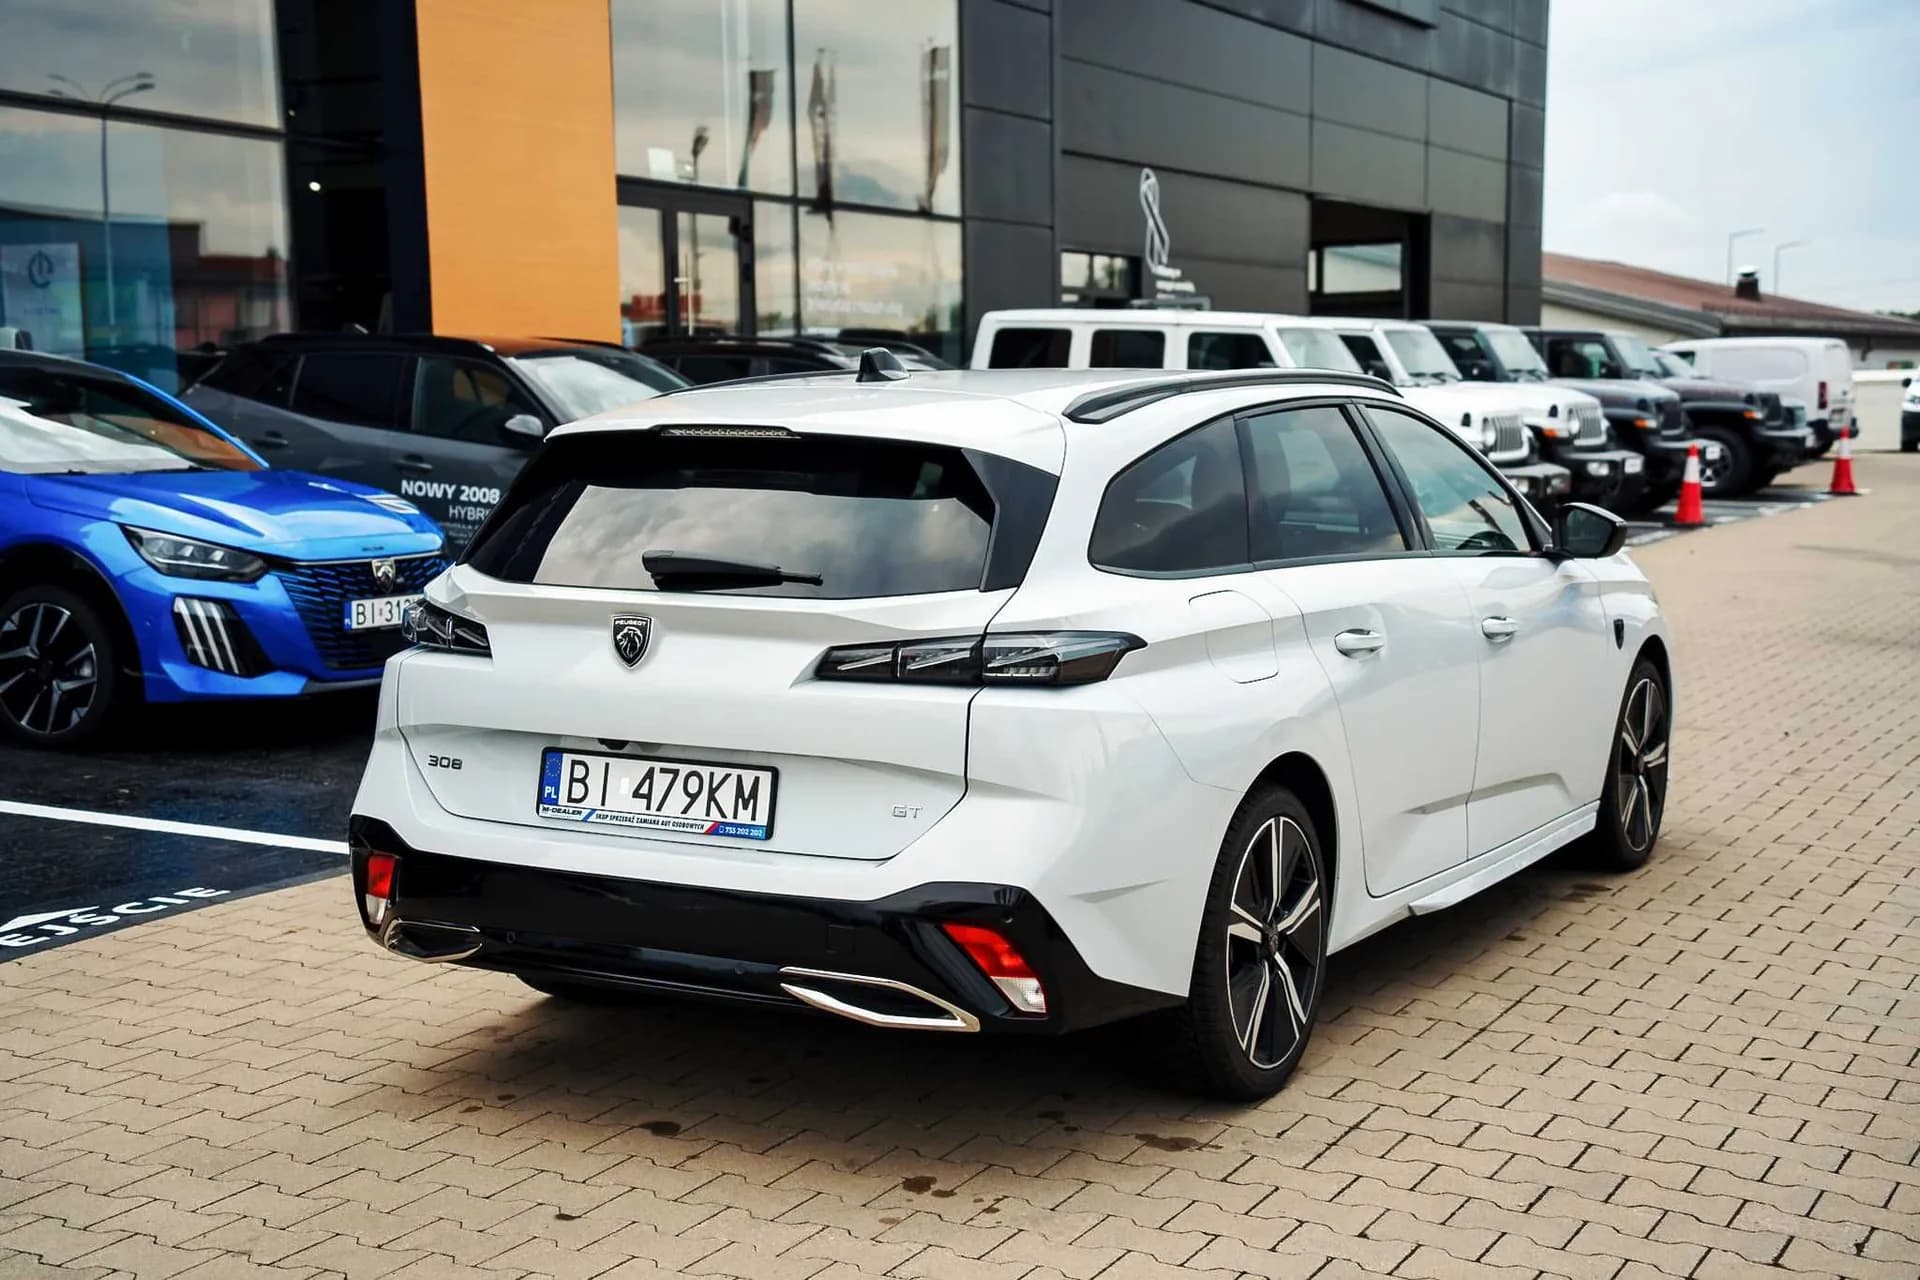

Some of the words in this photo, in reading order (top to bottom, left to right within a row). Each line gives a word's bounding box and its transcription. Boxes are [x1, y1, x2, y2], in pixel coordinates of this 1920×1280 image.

[401, 480, 456, 499] NOWY
[460, 485, 501, 504] 2008
[356, 603, 374, 626] BI
[385, 598, 418, 622] 31
[428, 755, 463, 770] 308
[544, 785, 558, 799] PL
[566, 759, 610, 807] BI
[632, 766, 760, 821] 479KM
[541, 805, 583, 816] M-DEALER
[892, 805, 923, 819] GT
